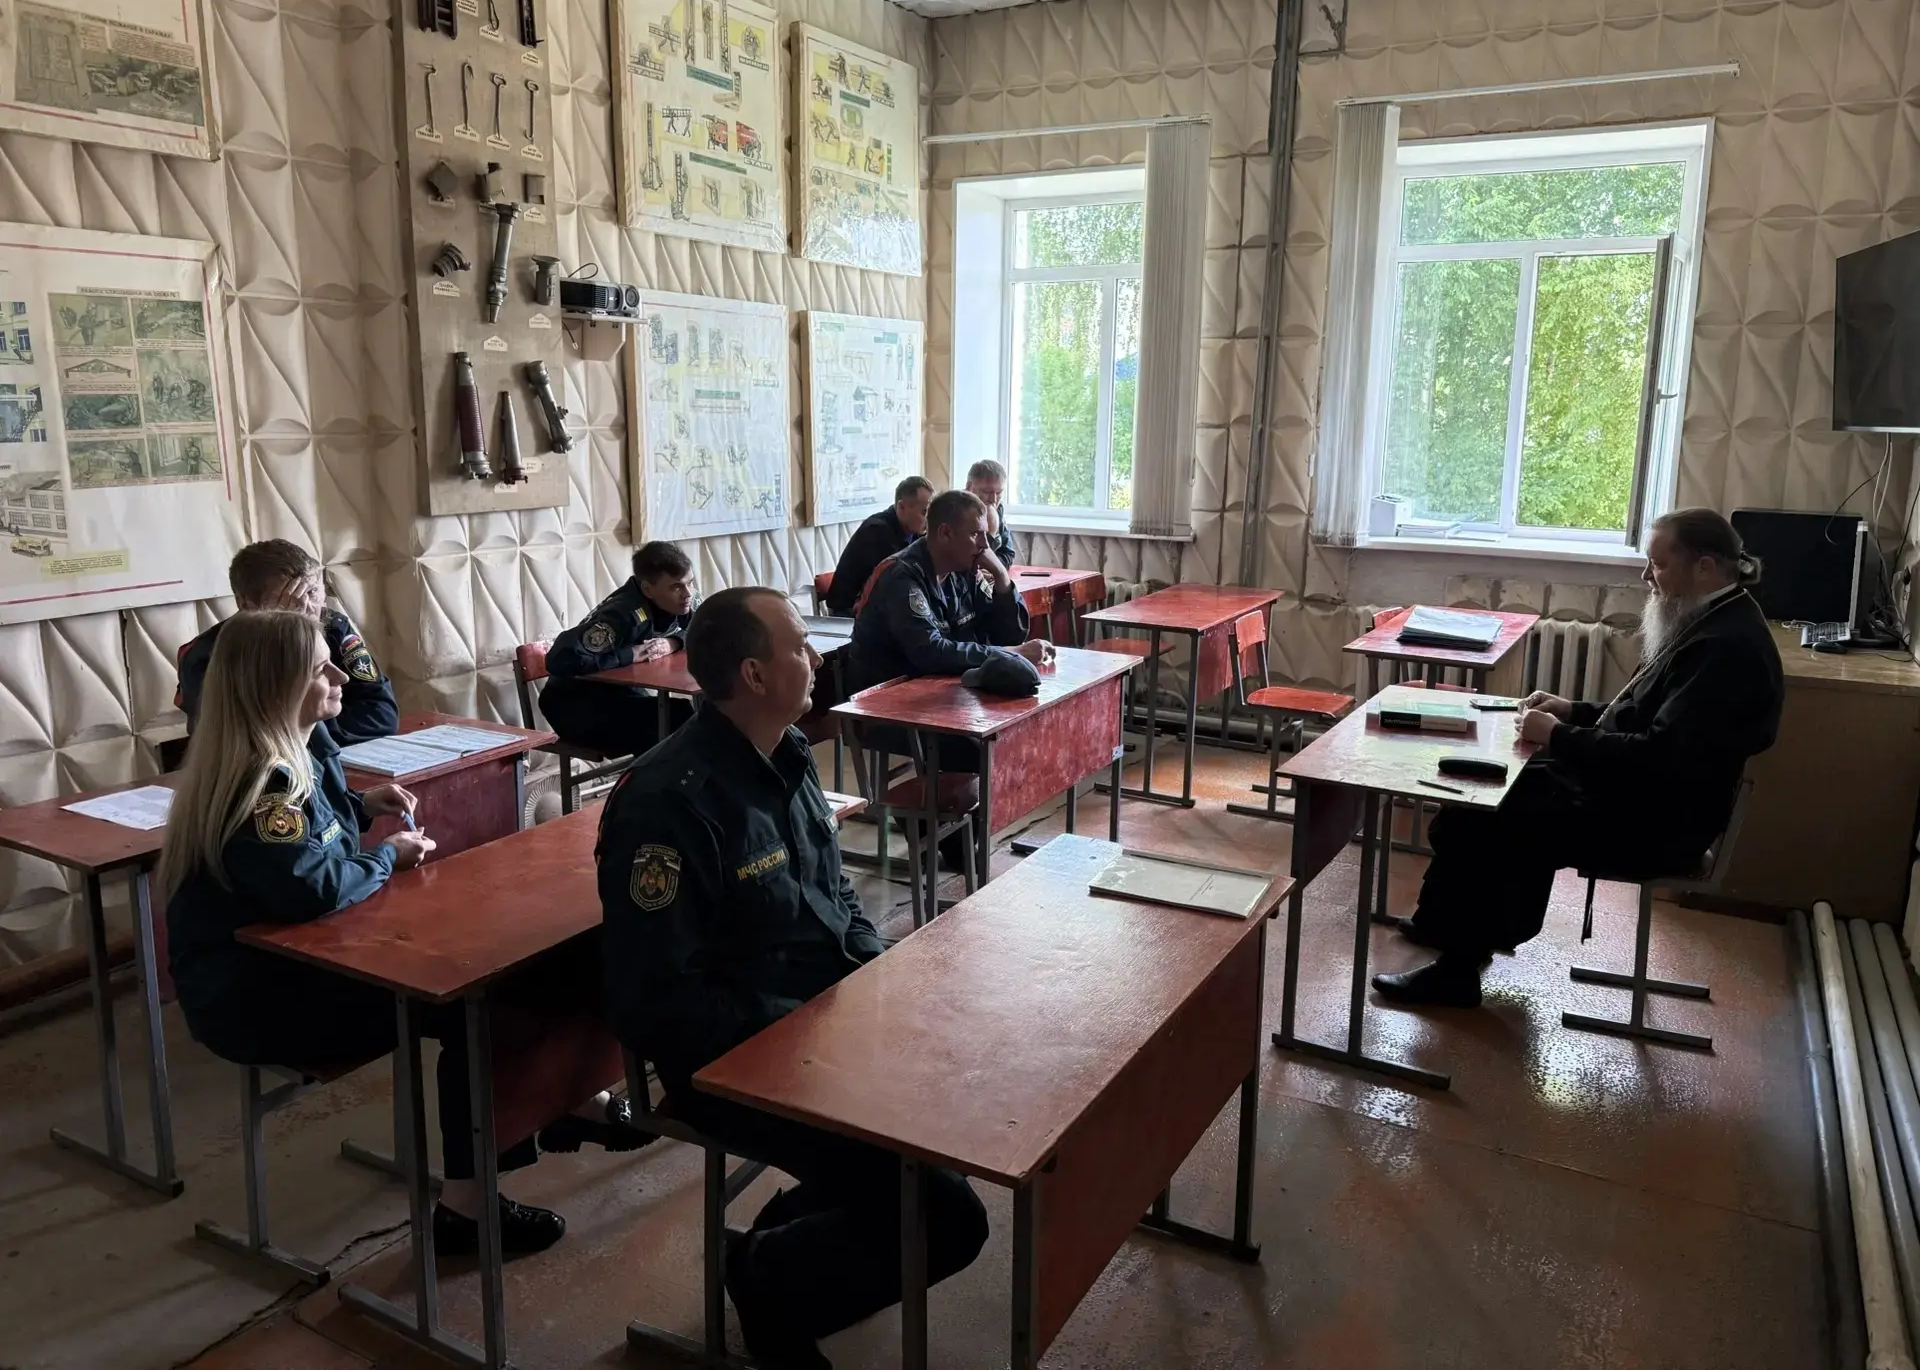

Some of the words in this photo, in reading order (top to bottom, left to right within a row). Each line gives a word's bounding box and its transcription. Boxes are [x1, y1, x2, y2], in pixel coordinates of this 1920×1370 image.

[745, 158, 772, 171] СТАРТ
[737, 862, 758, 880] МЧС
[757, 849, 787, 870] РОССИИ
